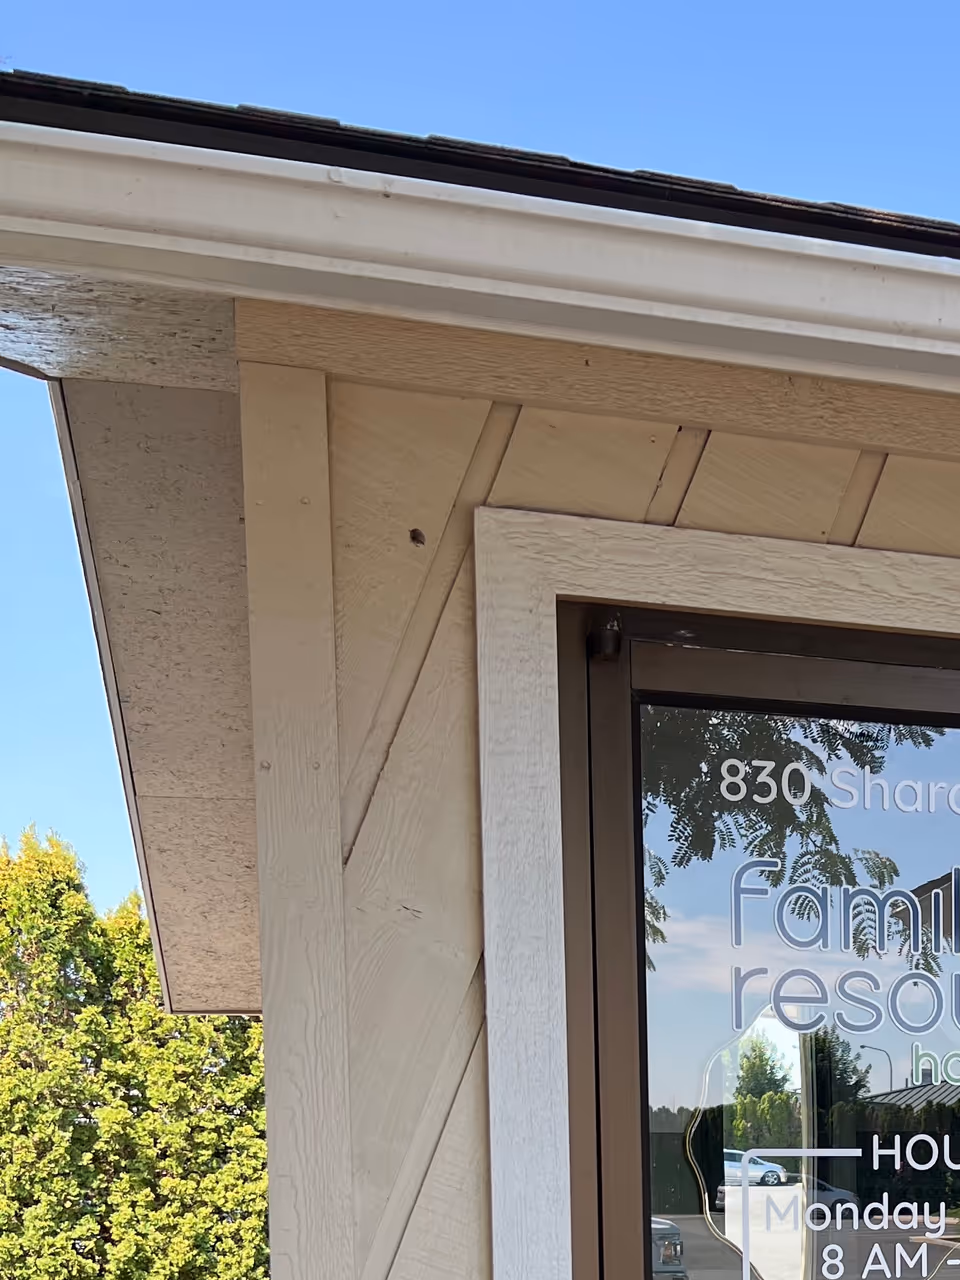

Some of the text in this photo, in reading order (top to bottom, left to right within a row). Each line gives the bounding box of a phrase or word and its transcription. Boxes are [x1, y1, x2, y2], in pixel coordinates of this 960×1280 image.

[720, 758, 812, 806] 830
[765, 1191, 946, 1239] Monday
[821, 1243, 845, 1280] 8
[861, 1242, 929, 1279] AM
